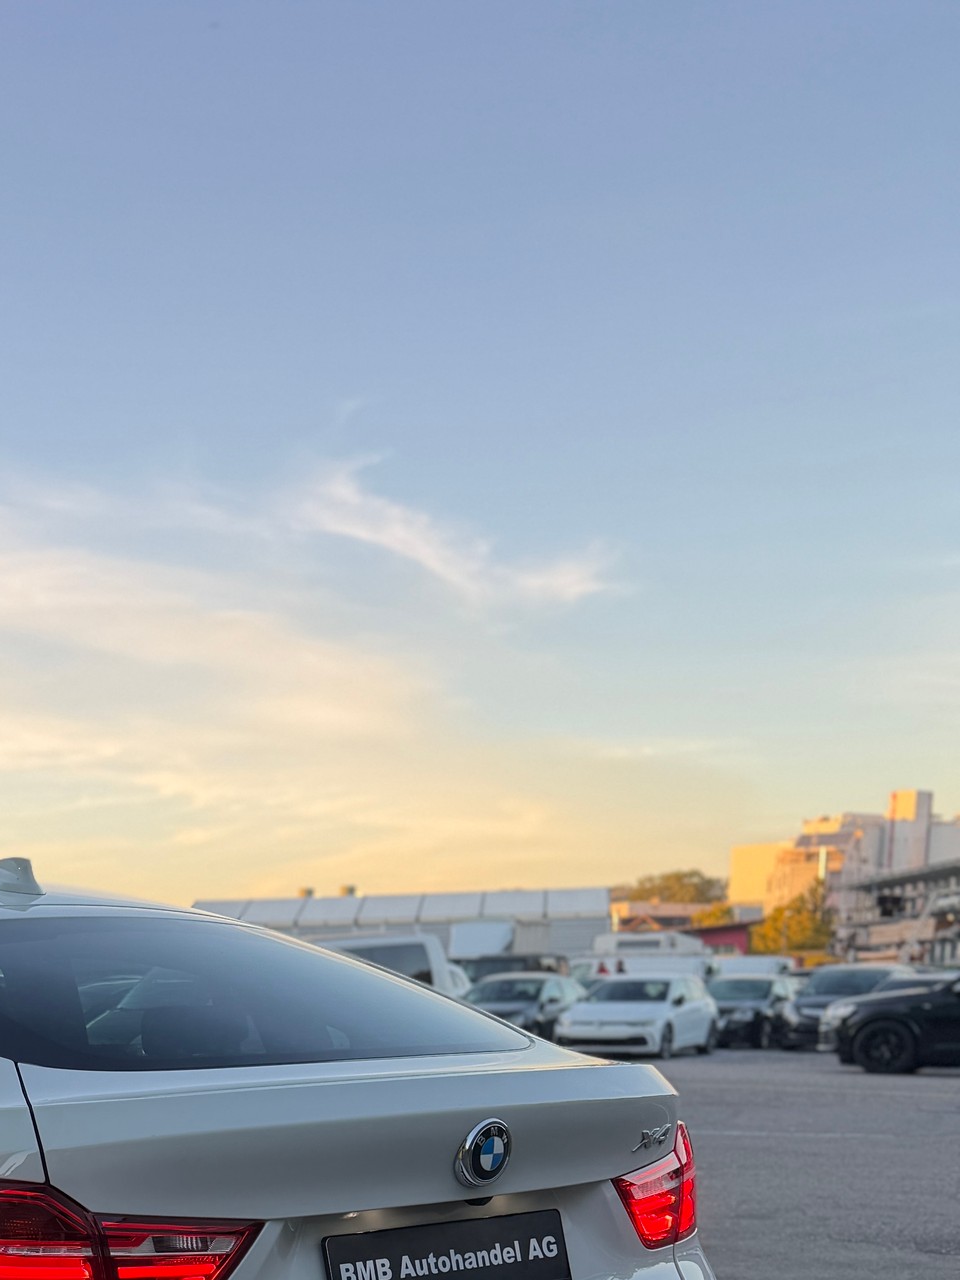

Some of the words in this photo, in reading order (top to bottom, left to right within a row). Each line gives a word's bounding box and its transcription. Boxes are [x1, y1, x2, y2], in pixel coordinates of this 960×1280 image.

[477, 1126, 508, 1146] BMW
[400, 1240, 522, 1279] Autohandel
[528, 1235, 558, 1260] AG
